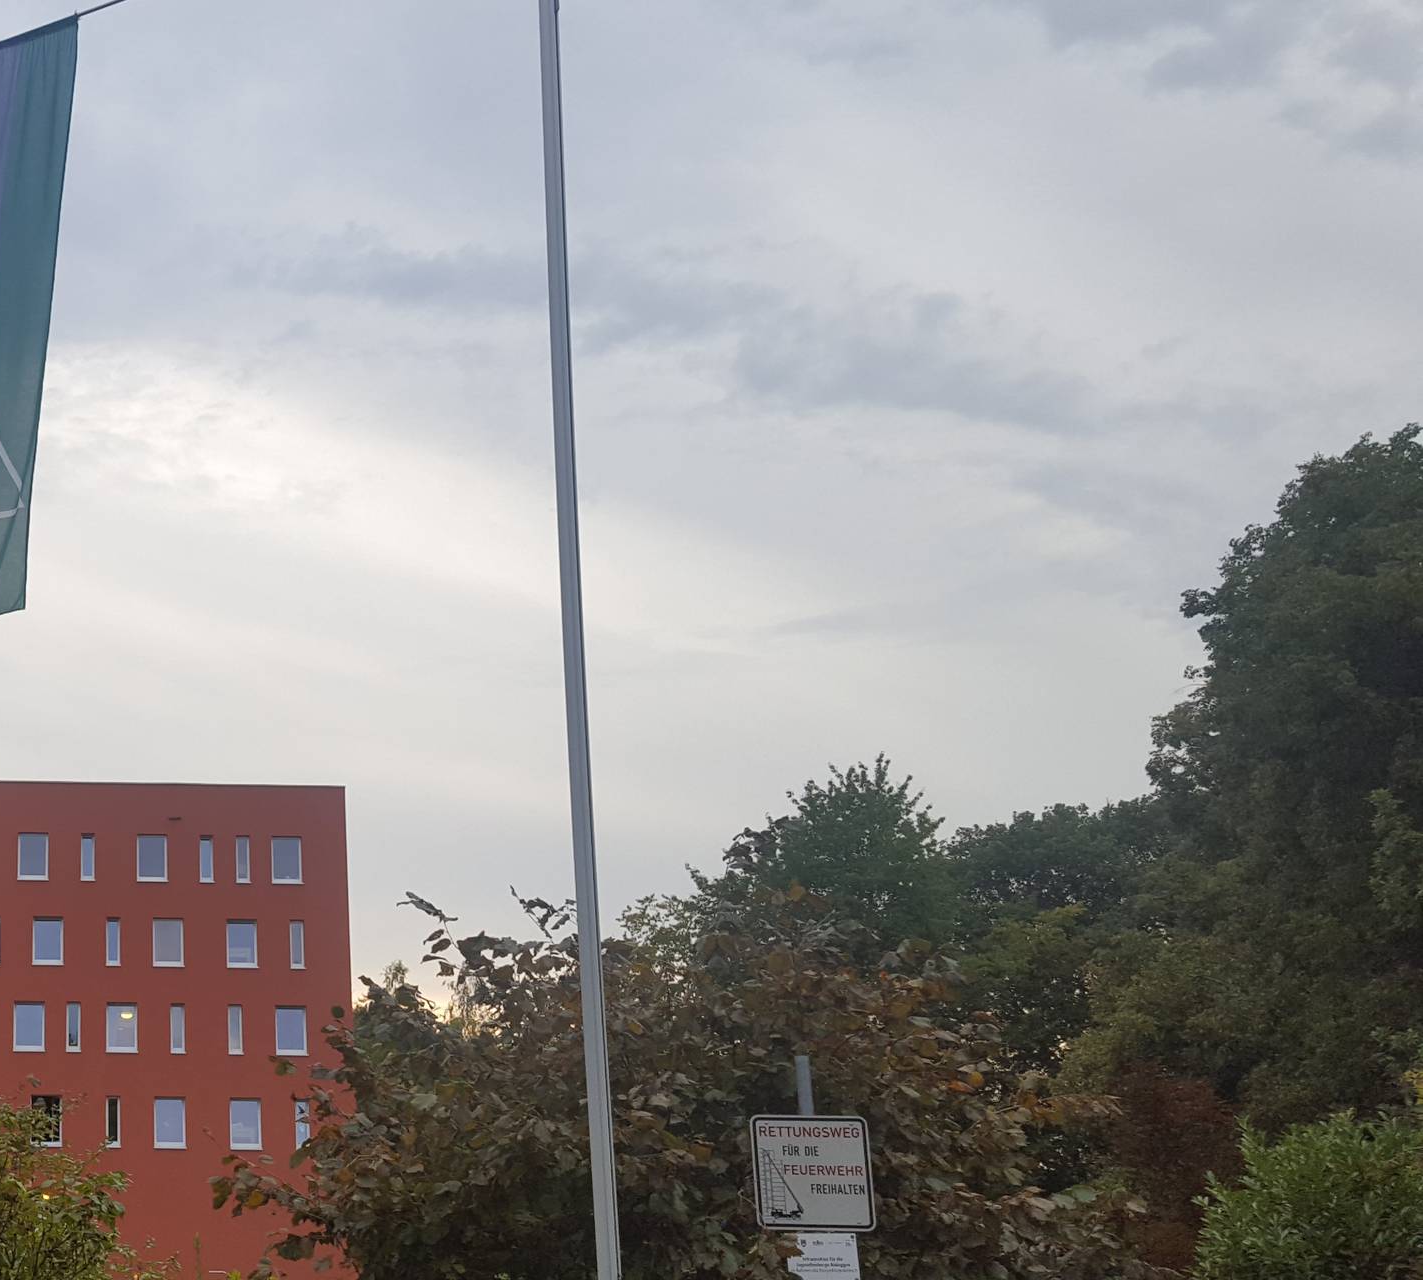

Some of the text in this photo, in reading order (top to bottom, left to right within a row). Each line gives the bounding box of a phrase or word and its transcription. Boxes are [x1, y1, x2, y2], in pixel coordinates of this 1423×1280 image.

[758, 1126, 860, 1139] RETTUNGSWEG
[782, 1145, 819, 1157] FÜR DIE
[783, 1164, 864, 1177] FEUERWEHR
[810, 1183, 866, 1195] FREIHALTEN
